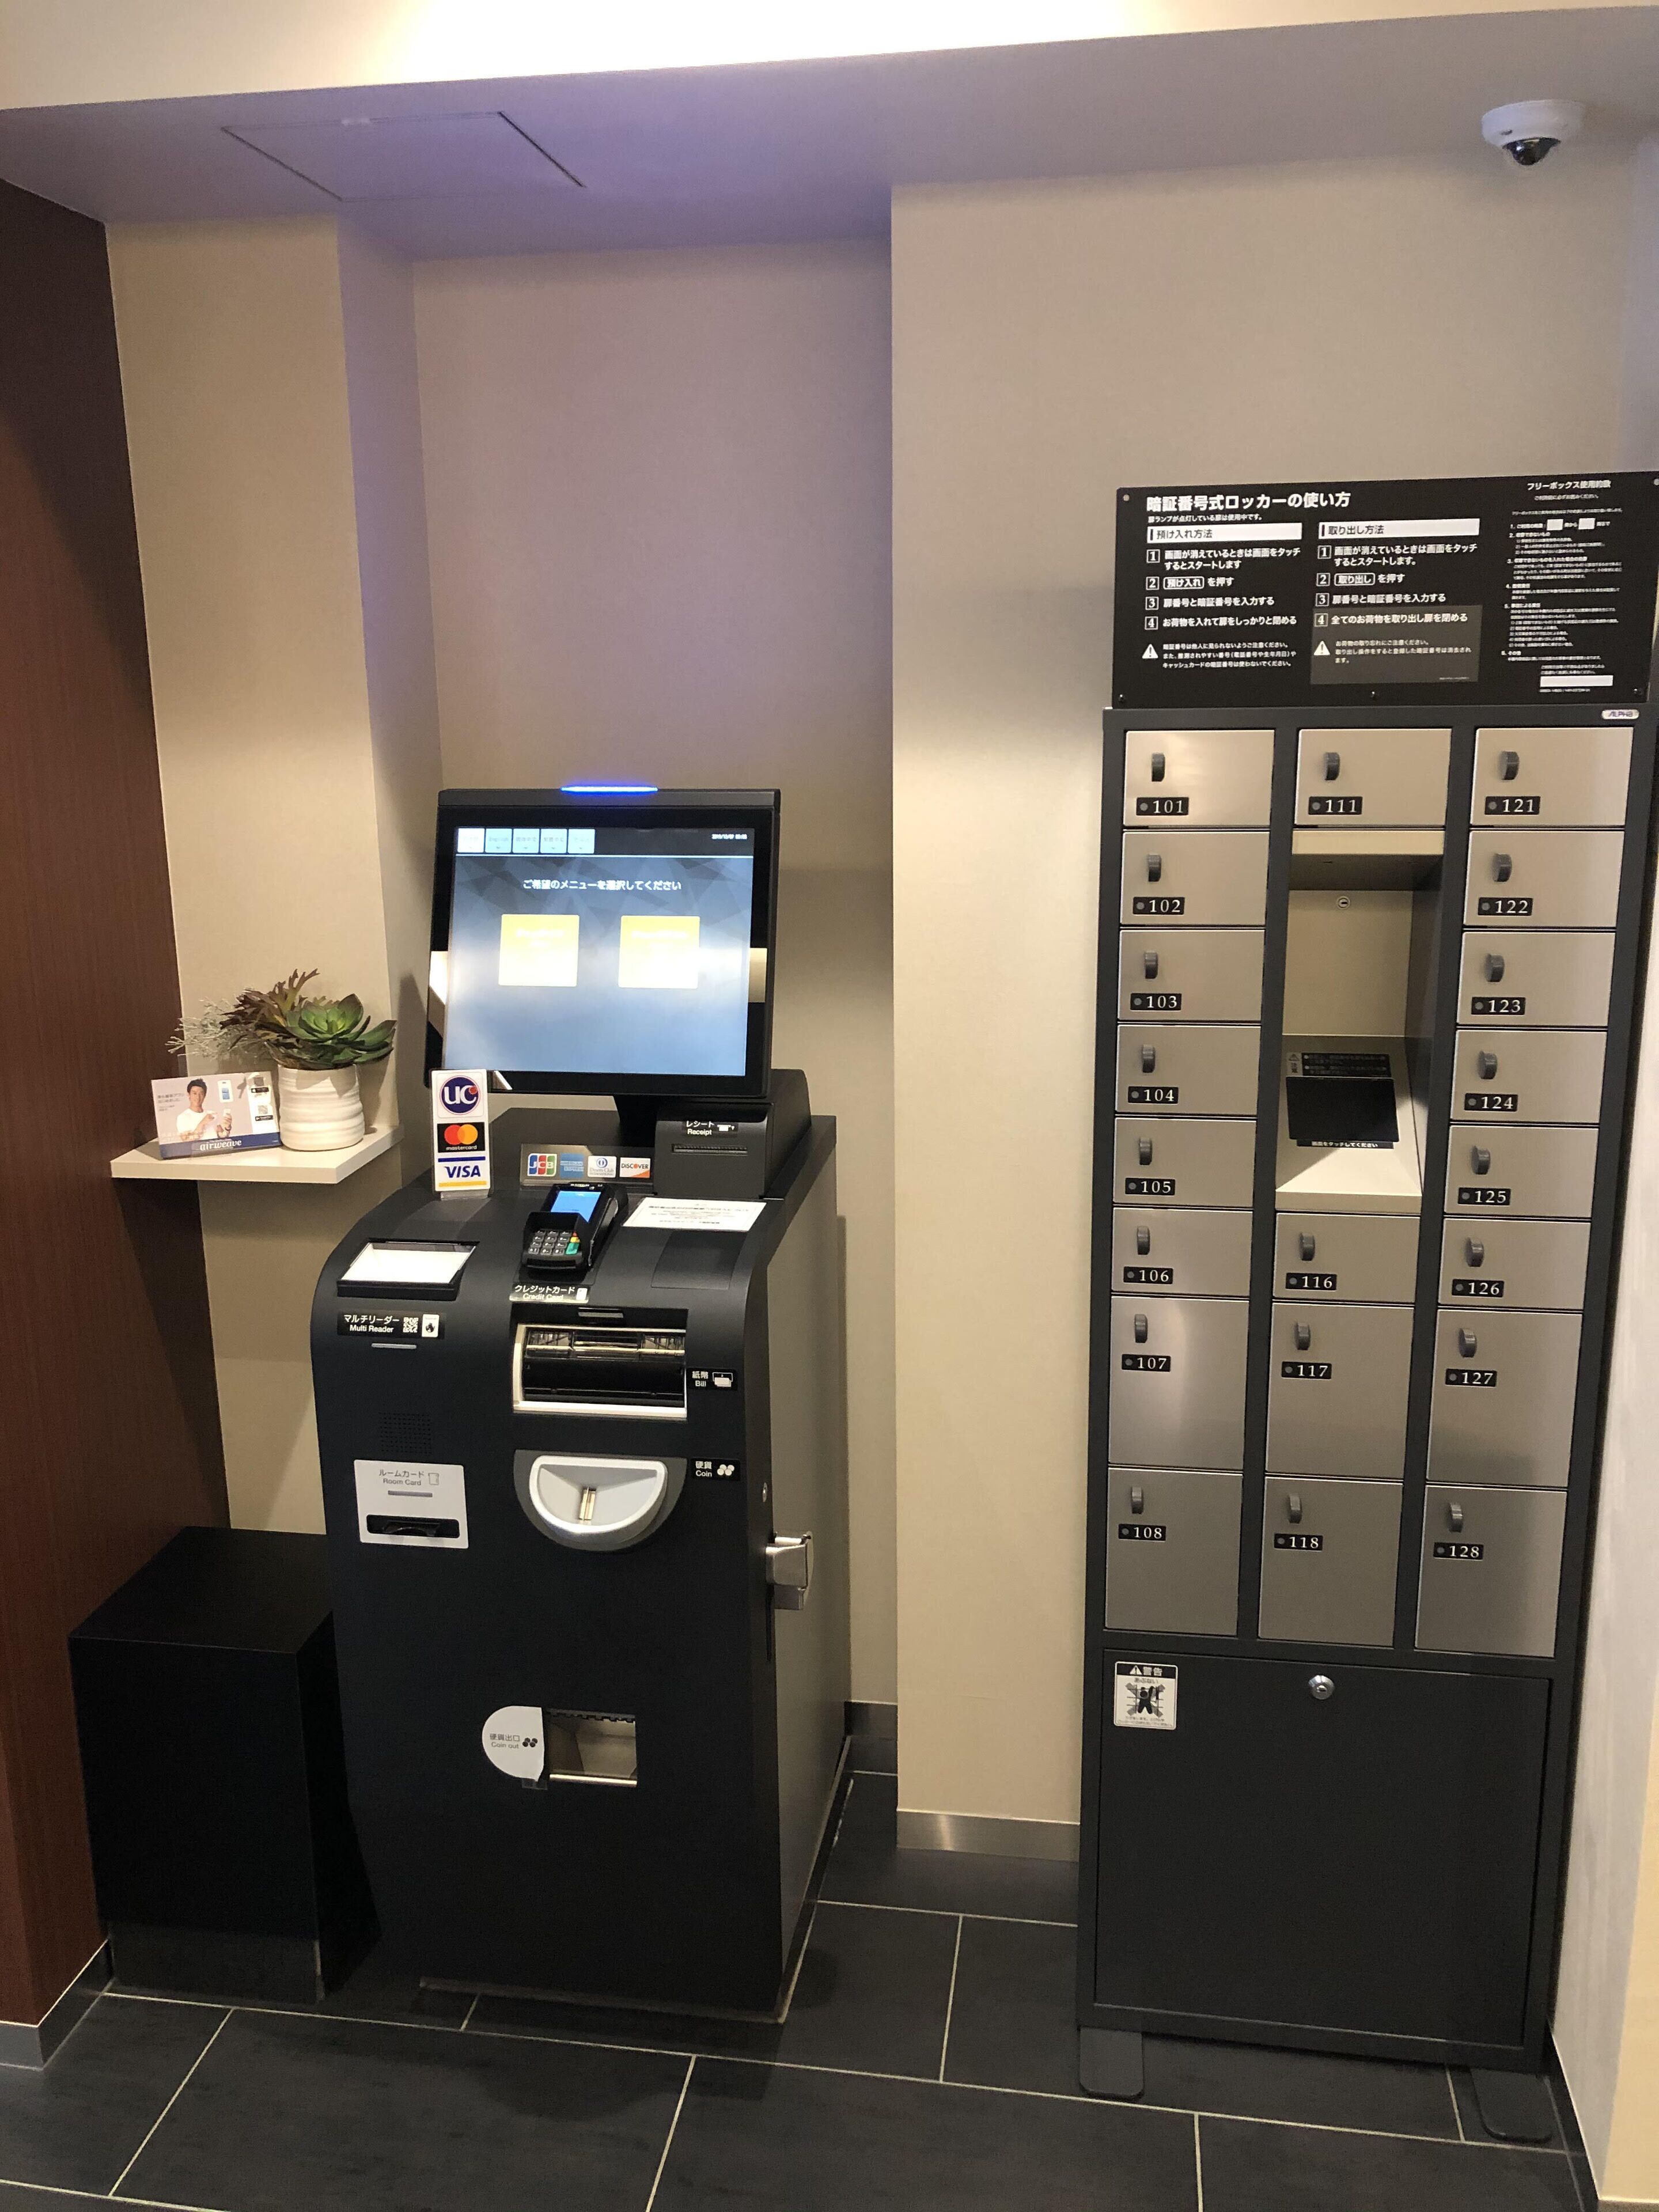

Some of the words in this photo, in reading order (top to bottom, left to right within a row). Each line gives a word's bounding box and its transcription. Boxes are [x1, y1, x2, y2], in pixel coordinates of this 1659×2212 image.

[1146, 491, 1351, 512] 暗証番号式ロッカーの使い方
[1157, 529, 1213, 540] 預け入れ方法
[1328, 525, 1384, 536] 取り出し方法
[1165, 548, 1300, 559] 画面が消えているときは画面をタッチ
[1335, 544, 1477, 555] 画面が消えているときは画面をタッチ
[1164, 560, 1241, 570] するとスタートします
[1335, 557, 1416, 566] するとスタートします。
[1167, 577, 1201, 588] 預け入れ
[1208, 577, 1234, 586] を押す
[1338, 575, 1372, 584] 取り出し
[1378, 574, 1405, 583] を押す
[1164, 597, 1274, 608] 扉番号と暗証番号を入力する
[1332, 594, 1446, 604] 扉番号と暗証番号を入力する
[1163, 616, 1297, 627] お荷物を入れて扉をしっかりと閉める
[1331, 613, 1468, 624] 全てのお荷物を取り出し扉を閉める
[1153, 800, 1183, 813] 101
[1326, 800, 1355, 812] 111
[1503, 799, 1533, 812] 121
[523, 879, 681, 891] ご希望のメニューを選択してください
[1150, 900, 1180, 912] 102
[1496, 900, 1527, 913] 122
[1147, 996, 1177, 1007] 103
[1489, 1000, 1520, 1012] 123
[1144, 1089, 1174, 1101] 104
[1482, 1097, 1513, 1109] 124
[687, 1128, 712, 1137] Receipt
[200, 1139, 242, 1151] airweave
[445, 1165, 481, 1179] VISA
[1142, 1181, 1171, 1193] 105
[1475, 1191, 1506, 1203] 125
[1139, 1270, 1168, 1282] 106
[1302, 1277, 1332, 1288] 116
[514, 1285, 575, 1294] クレジットカード
[1469, 1283, 1499, 1294] 126
[344, 1315, 399, 1324] マルチリーダー
[369, 1325, 394, 1333] Reader
[1137, 1358, 1166, 1369] 107
[692, 1371, 709, 1379] 紙幣
[1298, 1365, 1328, 1377] 117
[1463, 1372, 1493, 1384] 127
[695, 1461, 712, 1469] 硬貨
[379, 1469, 425, 1478] ルームカード
[1134, 1527, 1161, 1539] 108
[1290, 1537, 1318, 1548] 118
[1450, 1546, 1479, 1558] 128
[1143, 1666, 1162, 1676] 警告
[490, 1733, 520, 1742] 硬貨出口
